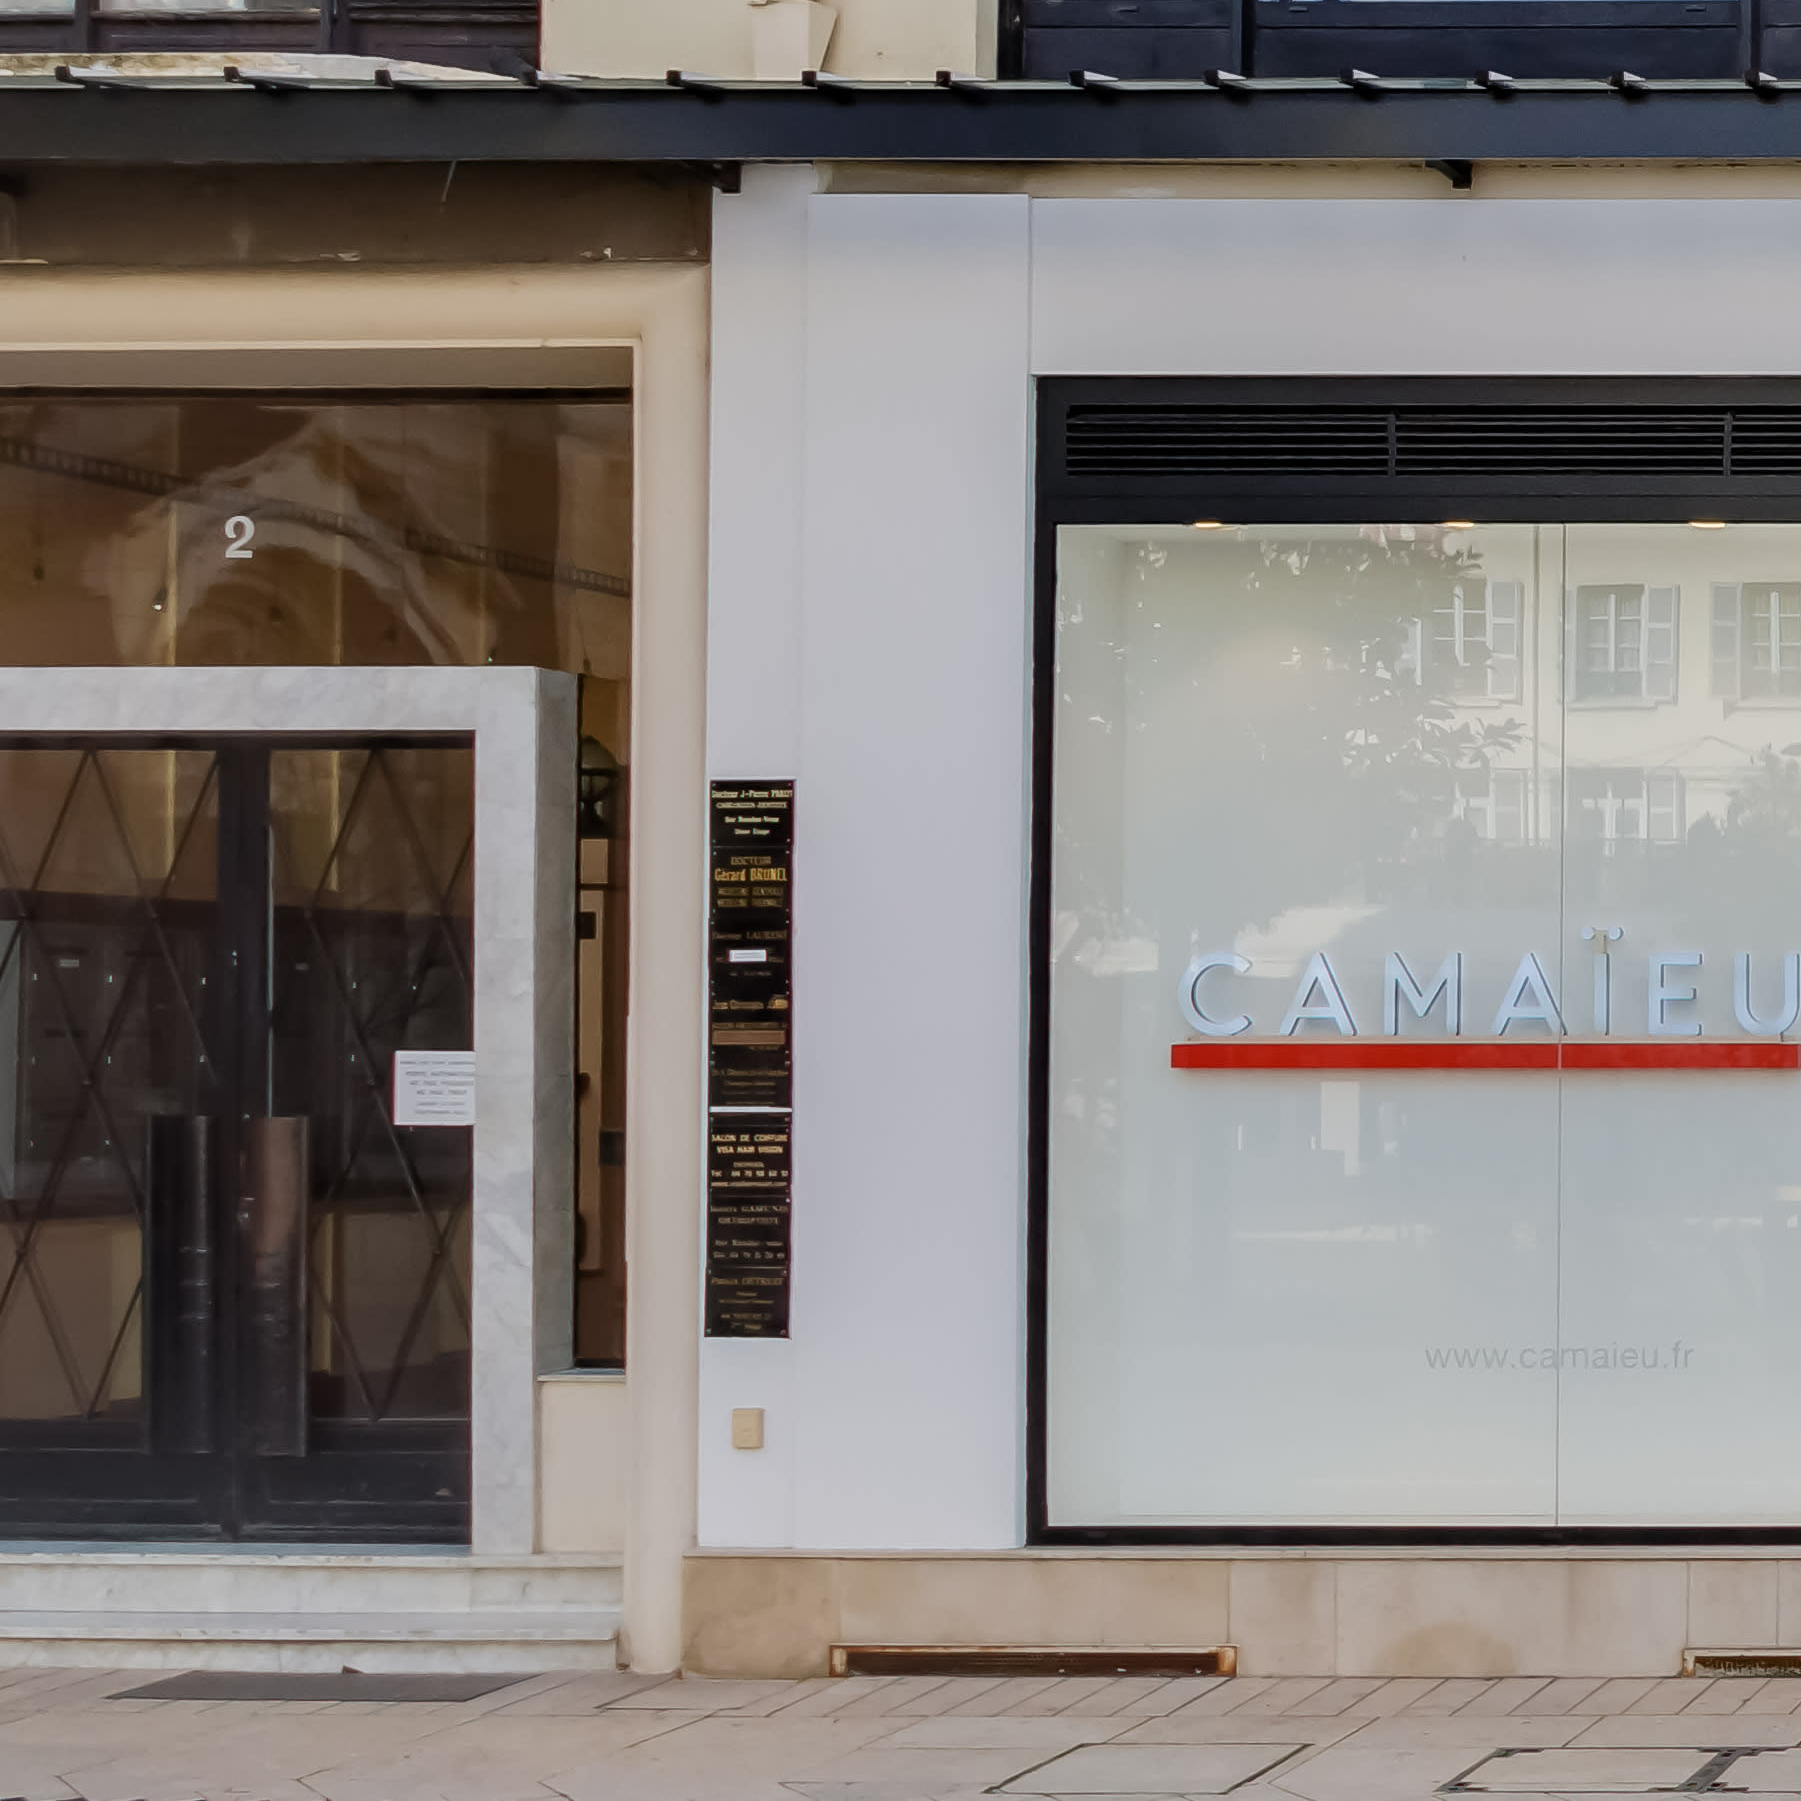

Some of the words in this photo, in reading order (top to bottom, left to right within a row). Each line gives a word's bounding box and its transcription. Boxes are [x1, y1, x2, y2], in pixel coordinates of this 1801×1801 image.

[224, 515, 255, 559] 2
[1177, 926, 1801, 1037] CAMAÏEU
[1425, 1341, 1696, 1373] www.camaieu.fr
